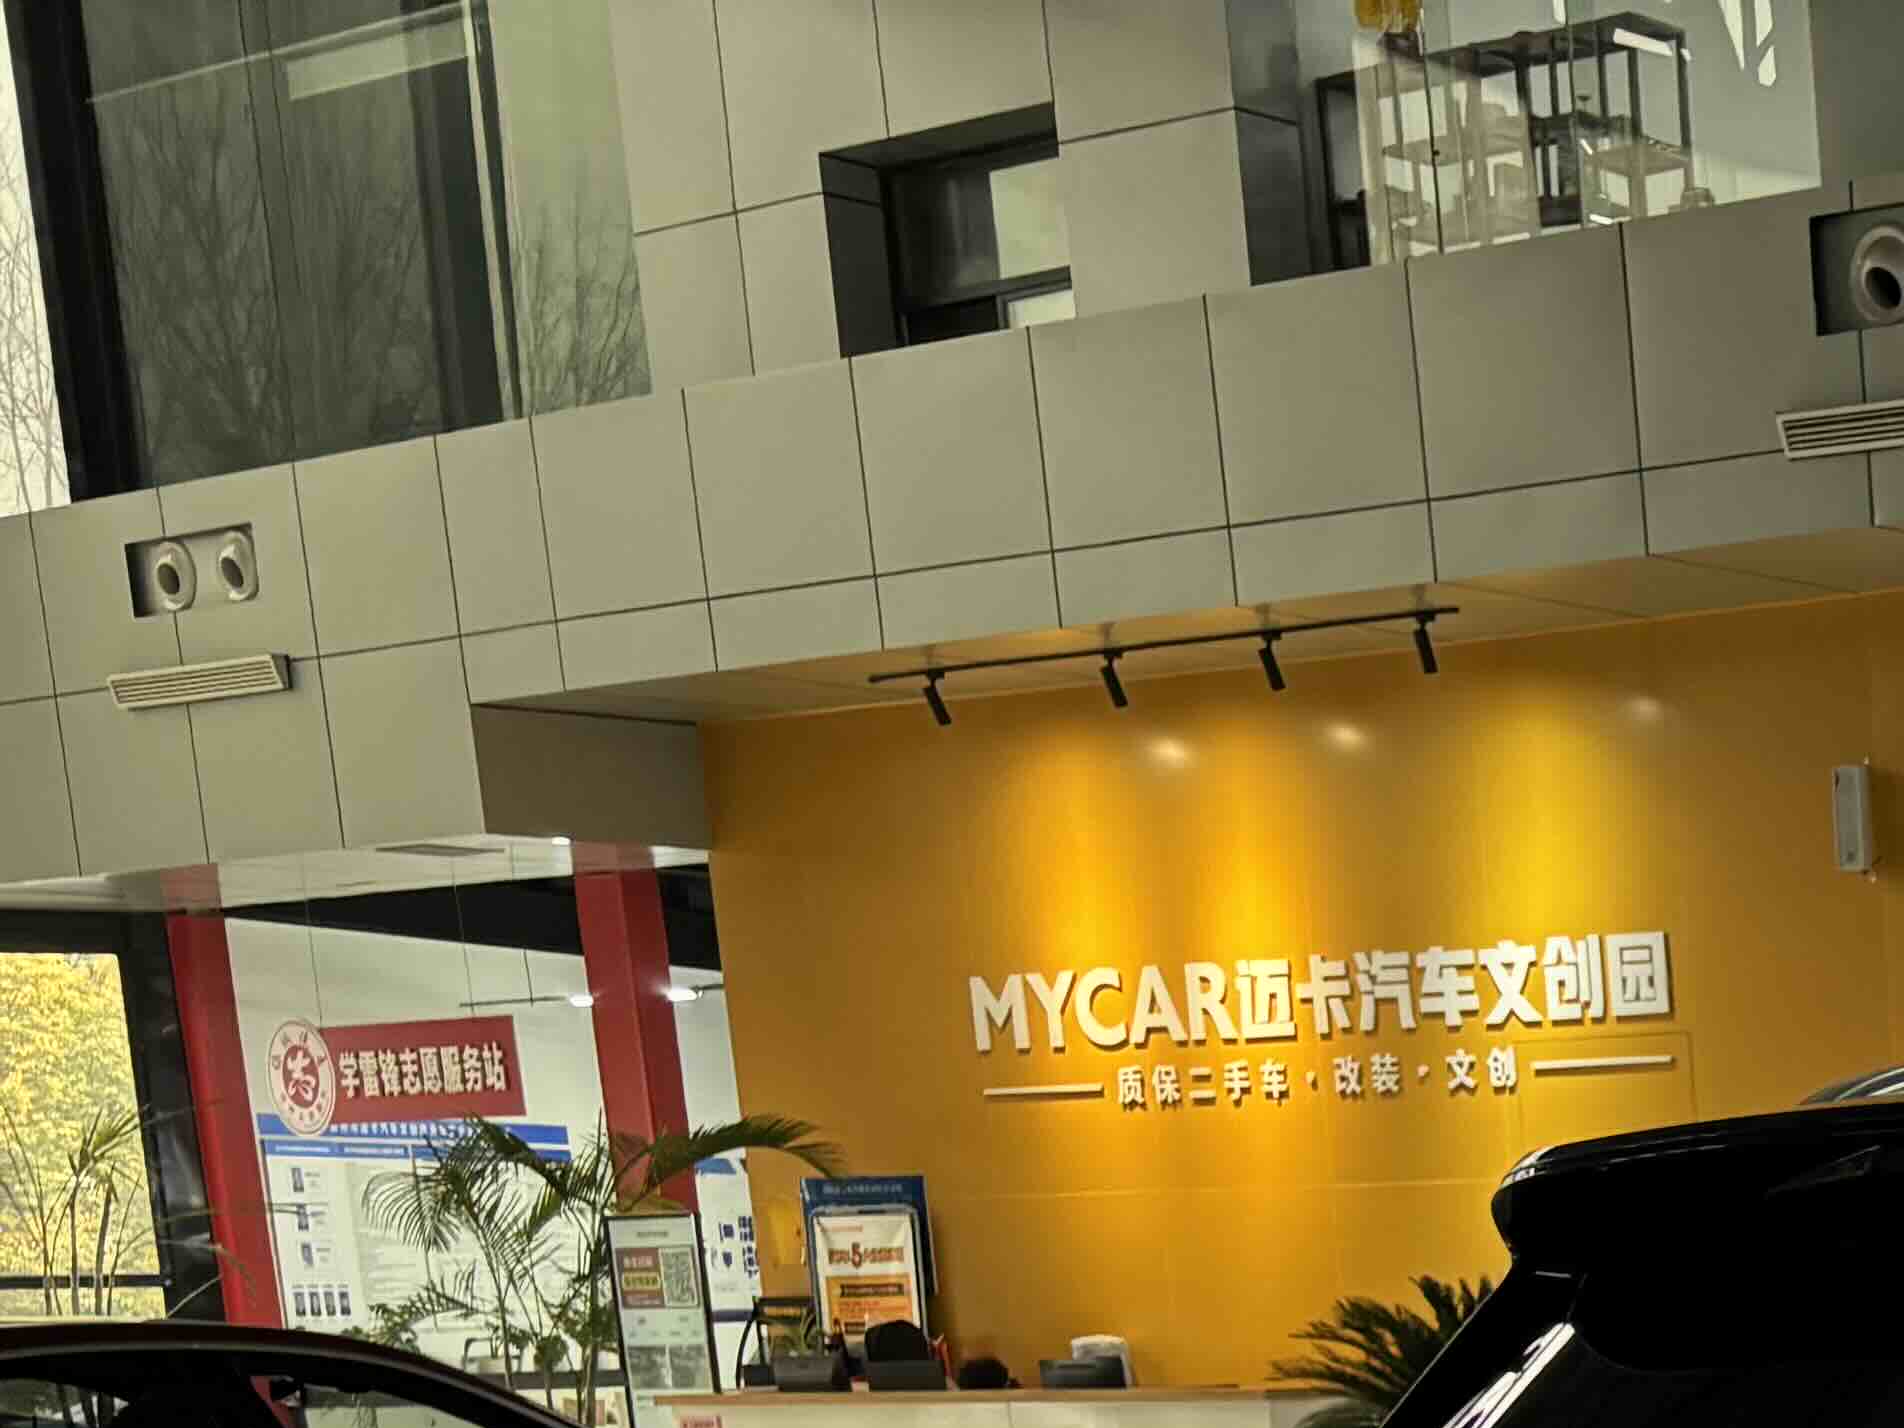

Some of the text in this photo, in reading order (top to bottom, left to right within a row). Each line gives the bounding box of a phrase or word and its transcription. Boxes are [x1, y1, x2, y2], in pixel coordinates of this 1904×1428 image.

[969, 932, 1673, 1052] MYCAR迈卡汽车文创园
[339, 1042, 507, 1098] 学雷锋志愿服务站
